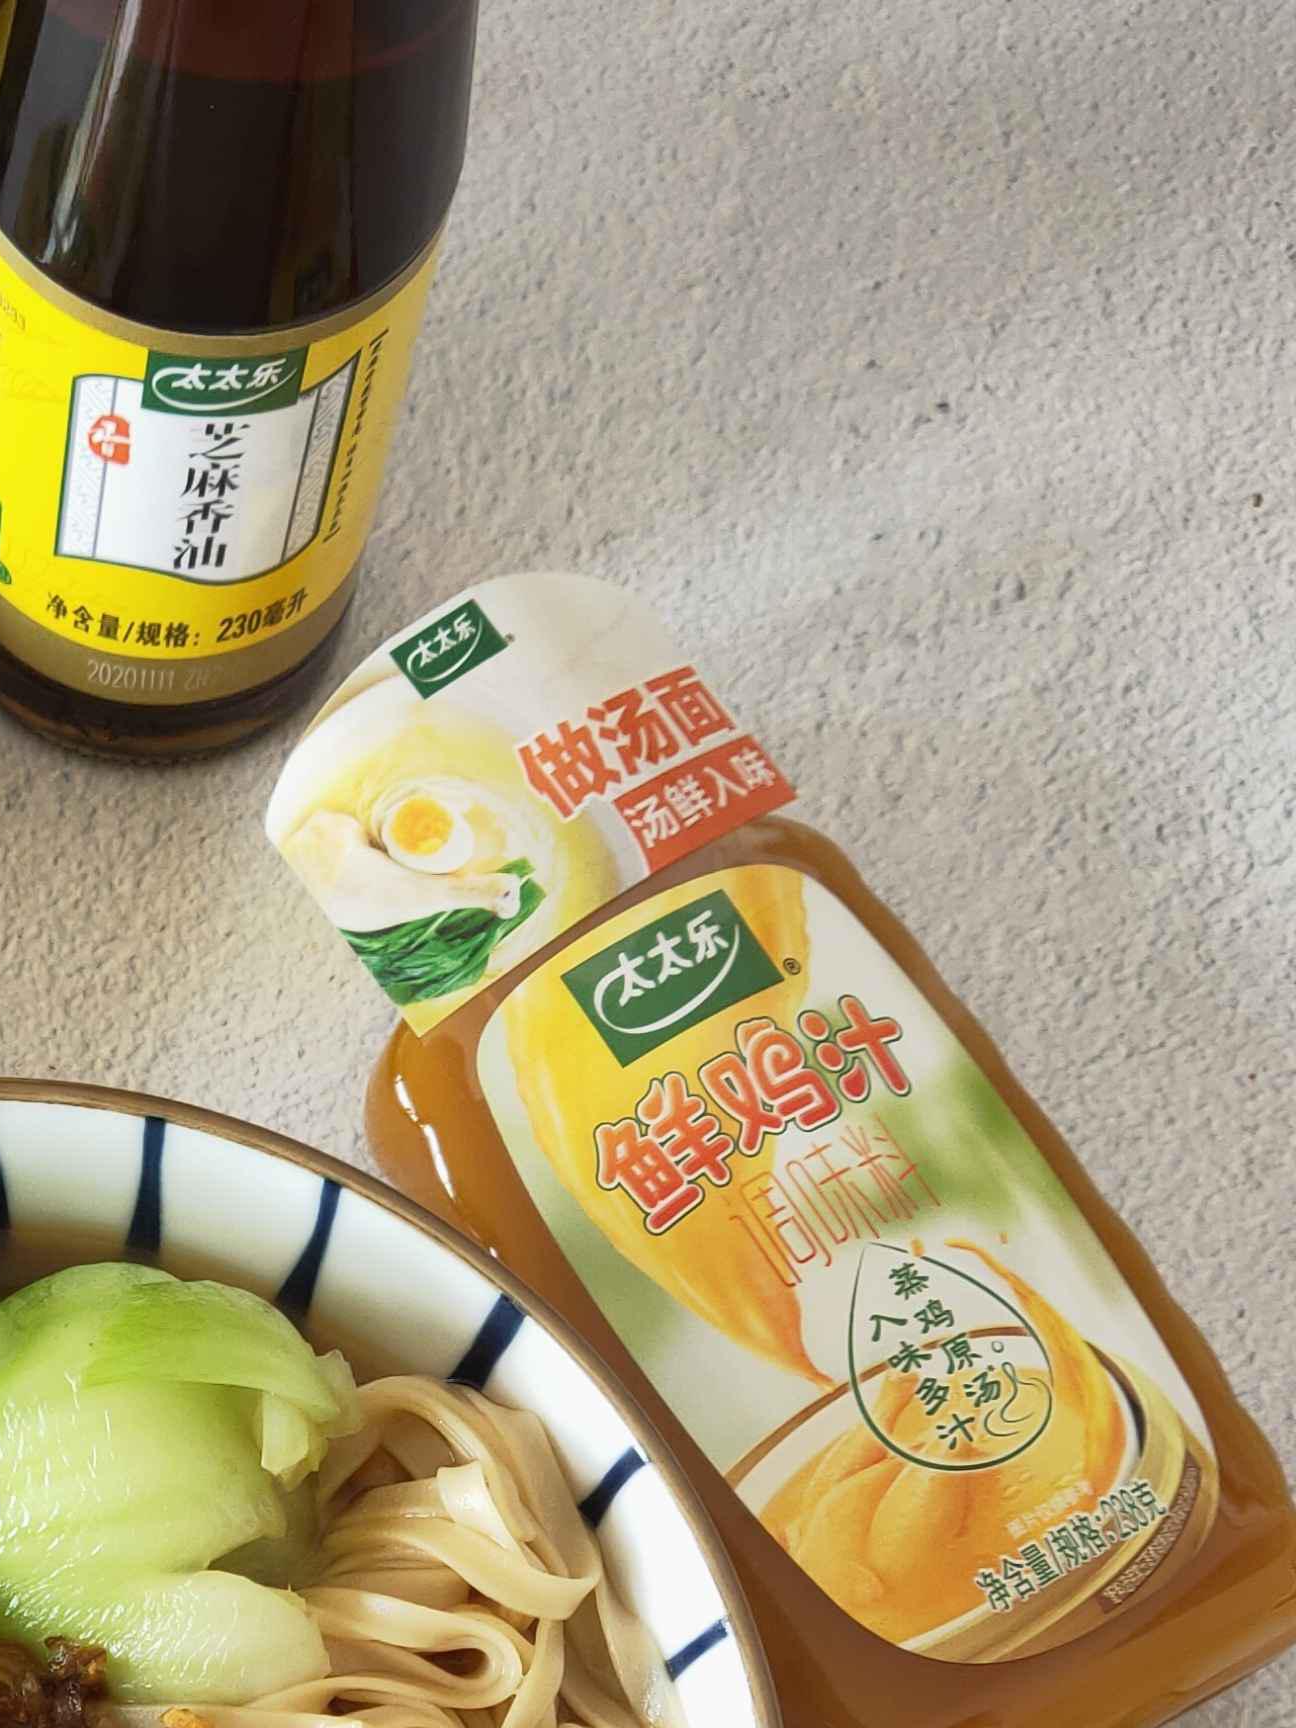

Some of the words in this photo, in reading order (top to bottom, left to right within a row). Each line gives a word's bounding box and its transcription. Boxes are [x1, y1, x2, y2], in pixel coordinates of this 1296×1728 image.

[170, 358, 287, 392] 太太乐
[172, 422, 251, 570] 芝麻香油
[87, 659, 176, 691] 20201111
[418, 612, 477, 667] 太太乐
[518, 664, 738, 820] 做汤面
[623, 749, 778, 849] 汤鲜入味
[617, 908, 730, 1008] 太太乐
[594, 994, 912, 1235] 鲜鸡汁
[722, 1111, 941, 1288] 调味料
[868, 1312, 975, 1450] 入味多汁
[888, 1262, 1002, 1409] 蒸鸡原汤
